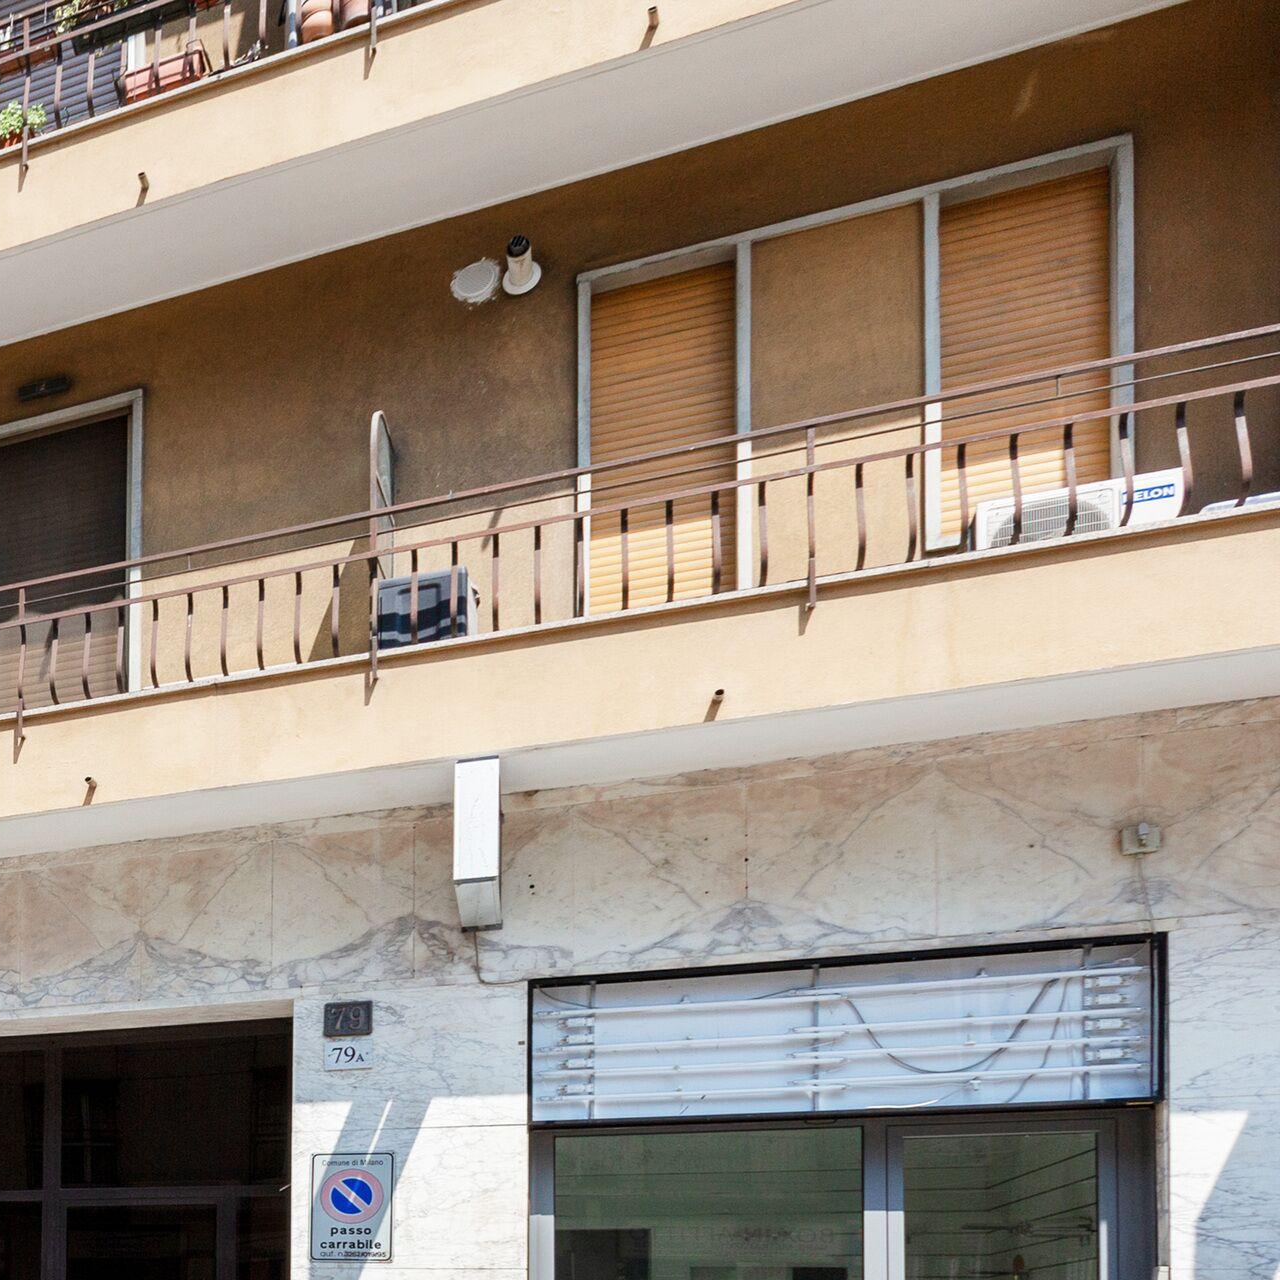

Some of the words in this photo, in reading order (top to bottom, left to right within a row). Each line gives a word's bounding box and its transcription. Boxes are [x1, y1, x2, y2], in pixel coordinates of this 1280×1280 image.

[331, 1006, 362, 1030] 79
[331, 1046, 365, 1064] 79A
[322, 1159, 350, 1167] Comune
[330, 1227, 372, 1237] passo
[320, 1239, 382, 1250] carrabile
